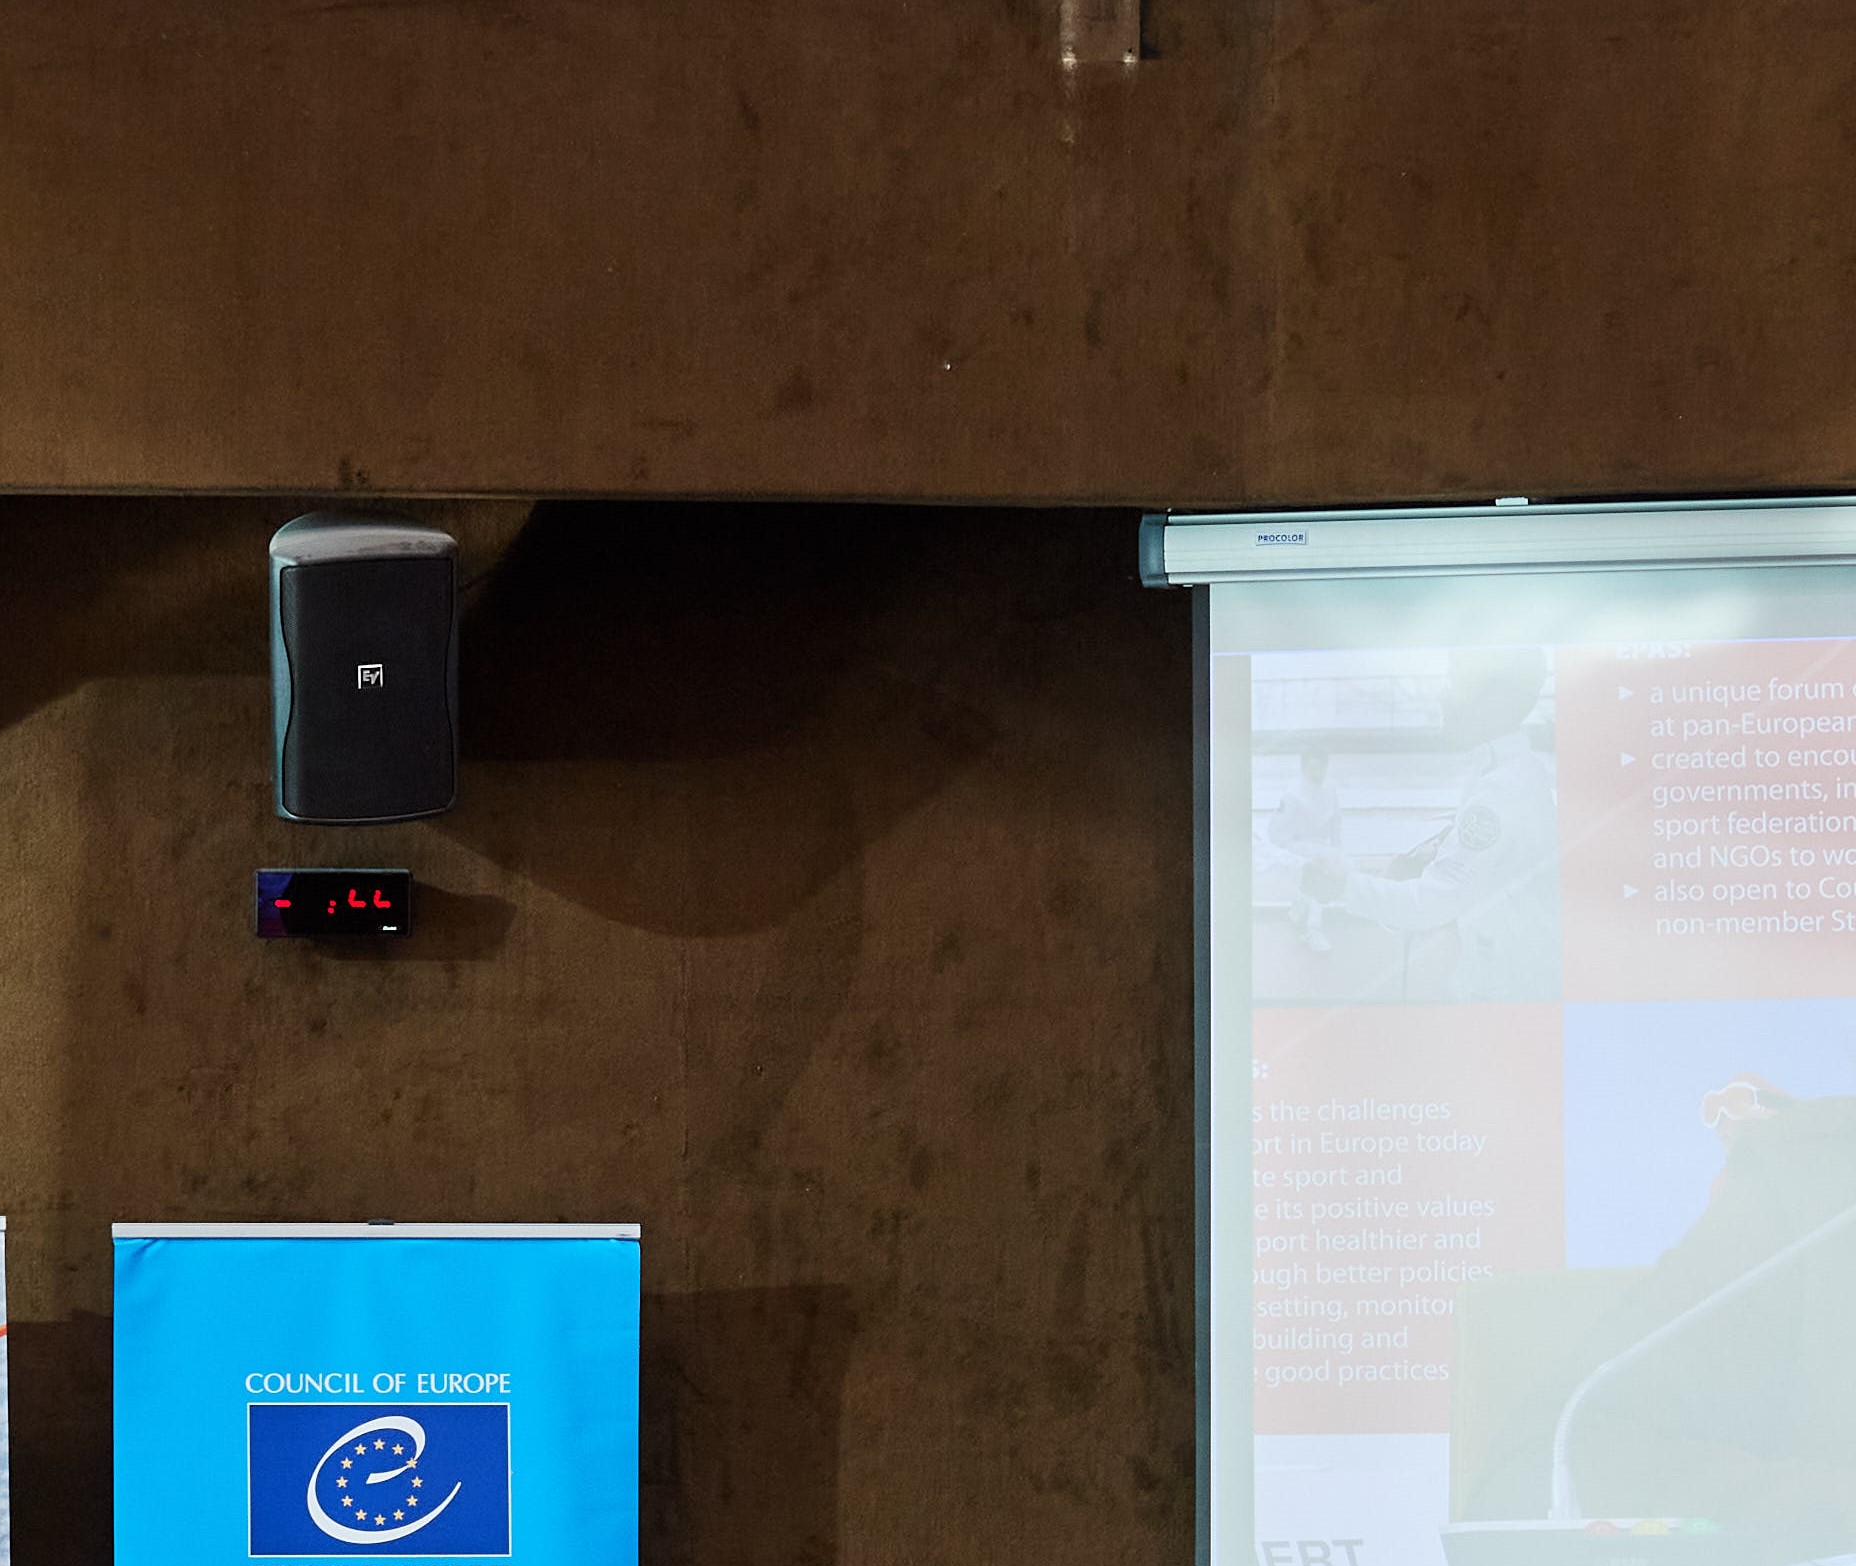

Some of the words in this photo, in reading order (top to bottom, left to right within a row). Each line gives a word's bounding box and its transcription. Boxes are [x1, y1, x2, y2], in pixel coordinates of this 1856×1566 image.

[1257, 532, 1305, 544] PROCOLOR
[1650, 686, 1663, 703] a
[1672, 680, 1761, 707] unique
[1768, 678, 1844, 701] forum
[1651, 715, 1675, 737] at
[1652, 747, 1747, 769] created
[1754, 747, 1780, 768] to
[1652, 779, 1828, 806] governments,
[1654, 813, 1720, 840] sport
[1654, 846, 1701, 868] and
[1710, 845, 1782, 867] NGOs
[1790, 847, 1815, 865] to
[1655, 880, 1704, 901] also
[1712, 881, 1777, 906] open
[1785, 880, 1811, 900] to
[1656, 913, 1824, 935] non-member
[1270, 1101, 1310, 1122] the
[1317, 1099, 1451, 1124] challenges
[1290, 1135, 1311, 1154] in
[1320, 1132, 1408, 1157] Europe
[1416, 1132, 1486, 1156] today
[1283, 1167, 1347, 1191] sport
[1355, 1165, 1403, 1186] and
[1276, 1198, 1303, 1219] its
[1311, 1198, 1409, 1224] positive
[1416, 1196, 1493, 1217] values
[1316, 1229, 1427, 1252] healthier
[1434, 1228, 1480, 1250] and
[1316, 1263, 1392, 1284] better
[1361, 1327, 1408, 1349] and
[245, 1372, 364, 1394] COUNCIL
[373, 1372, 407, 1394] OF
[417, 1372, 511, 1393] EUROPE
[1265, 1360, 1330, 1386] good
[1338, 1360, 1448, 1385] practices
